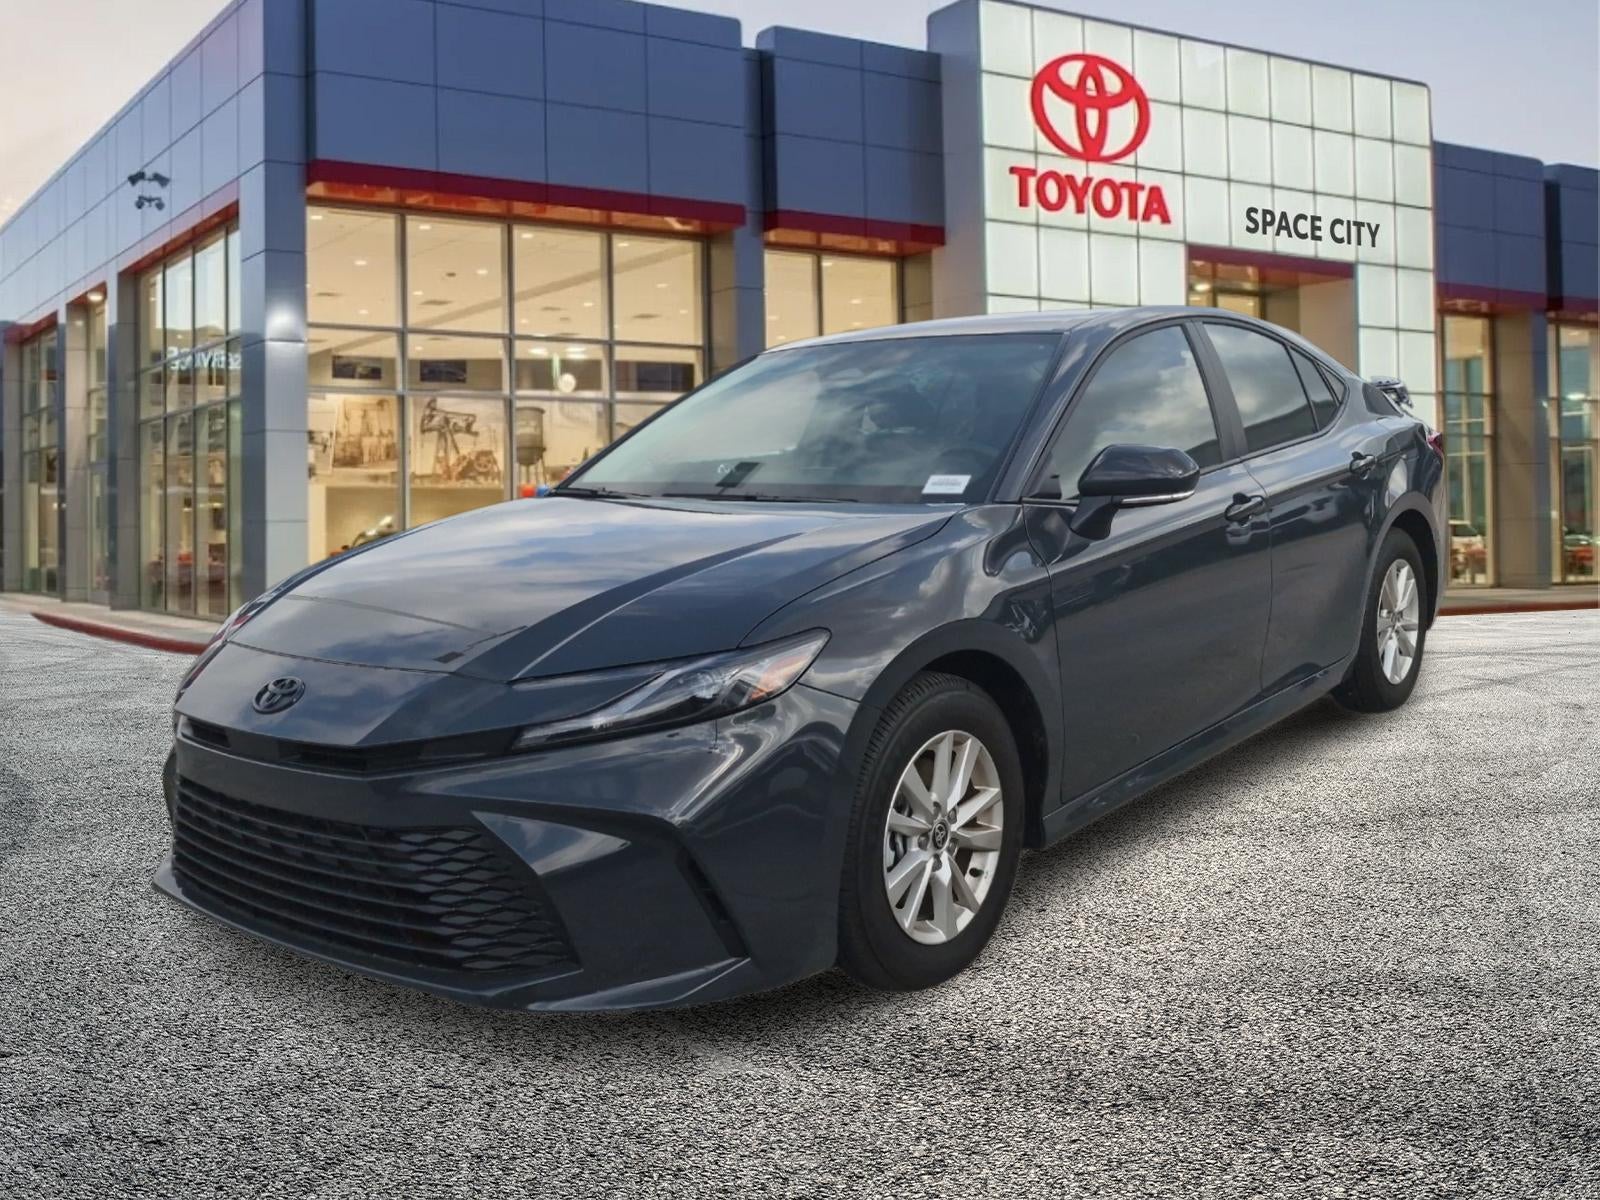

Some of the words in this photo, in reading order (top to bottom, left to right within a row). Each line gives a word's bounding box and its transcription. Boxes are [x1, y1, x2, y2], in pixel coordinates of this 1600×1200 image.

[1009, 166, 1170, 224] TOYOTA
[1245, 206, 1323, 242] SPACE
[1329, 217, 1381, 248] CITY
